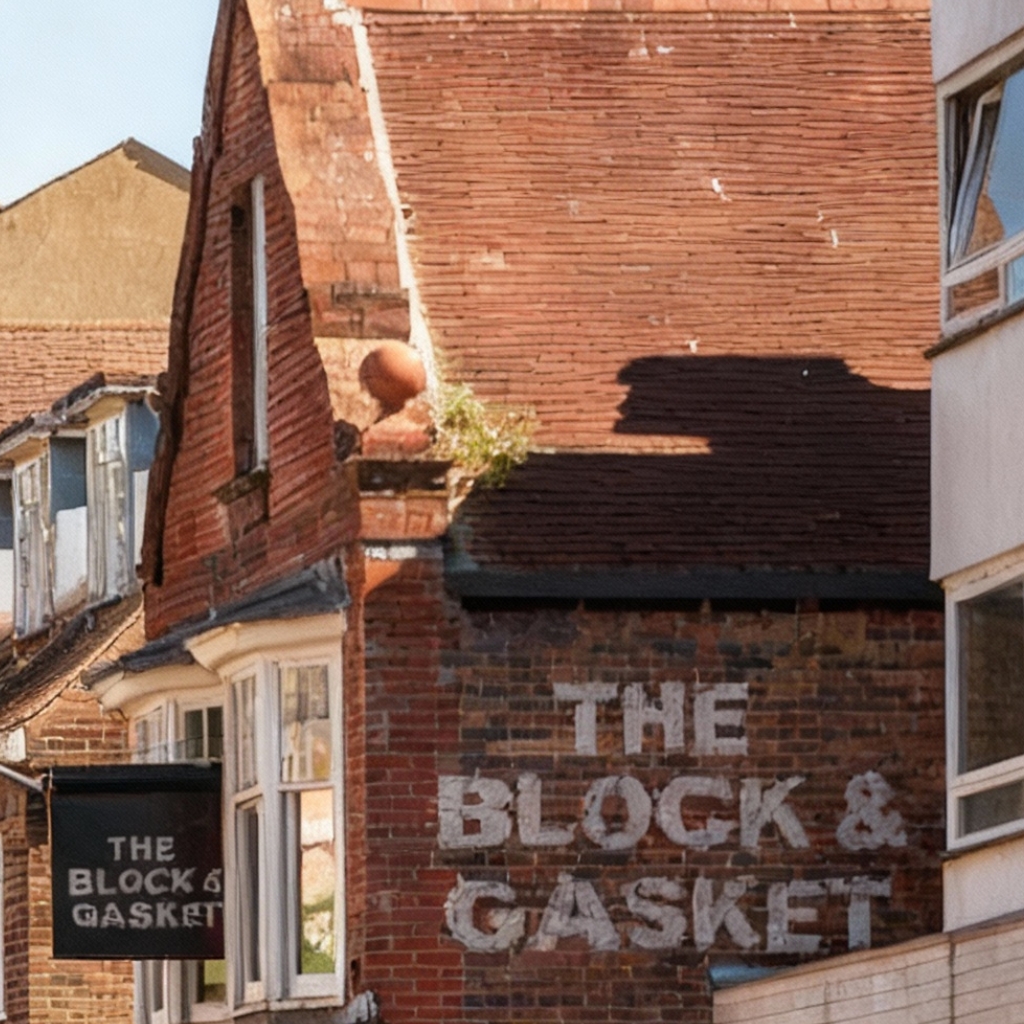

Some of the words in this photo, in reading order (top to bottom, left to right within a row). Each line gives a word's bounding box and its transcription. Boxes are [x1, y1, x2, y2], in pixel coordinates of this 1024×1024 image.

[553, 681, 749, 757] THE
[437, 772, 810, 850] BLOCK
[835, 770, 908, 850] &
[107, 836, 176, 862] THE
[68, 867, 197, 896] BLOCK
[72, 901, 224, 929] GASKET
[444, 873, 892, 953] GASKET
